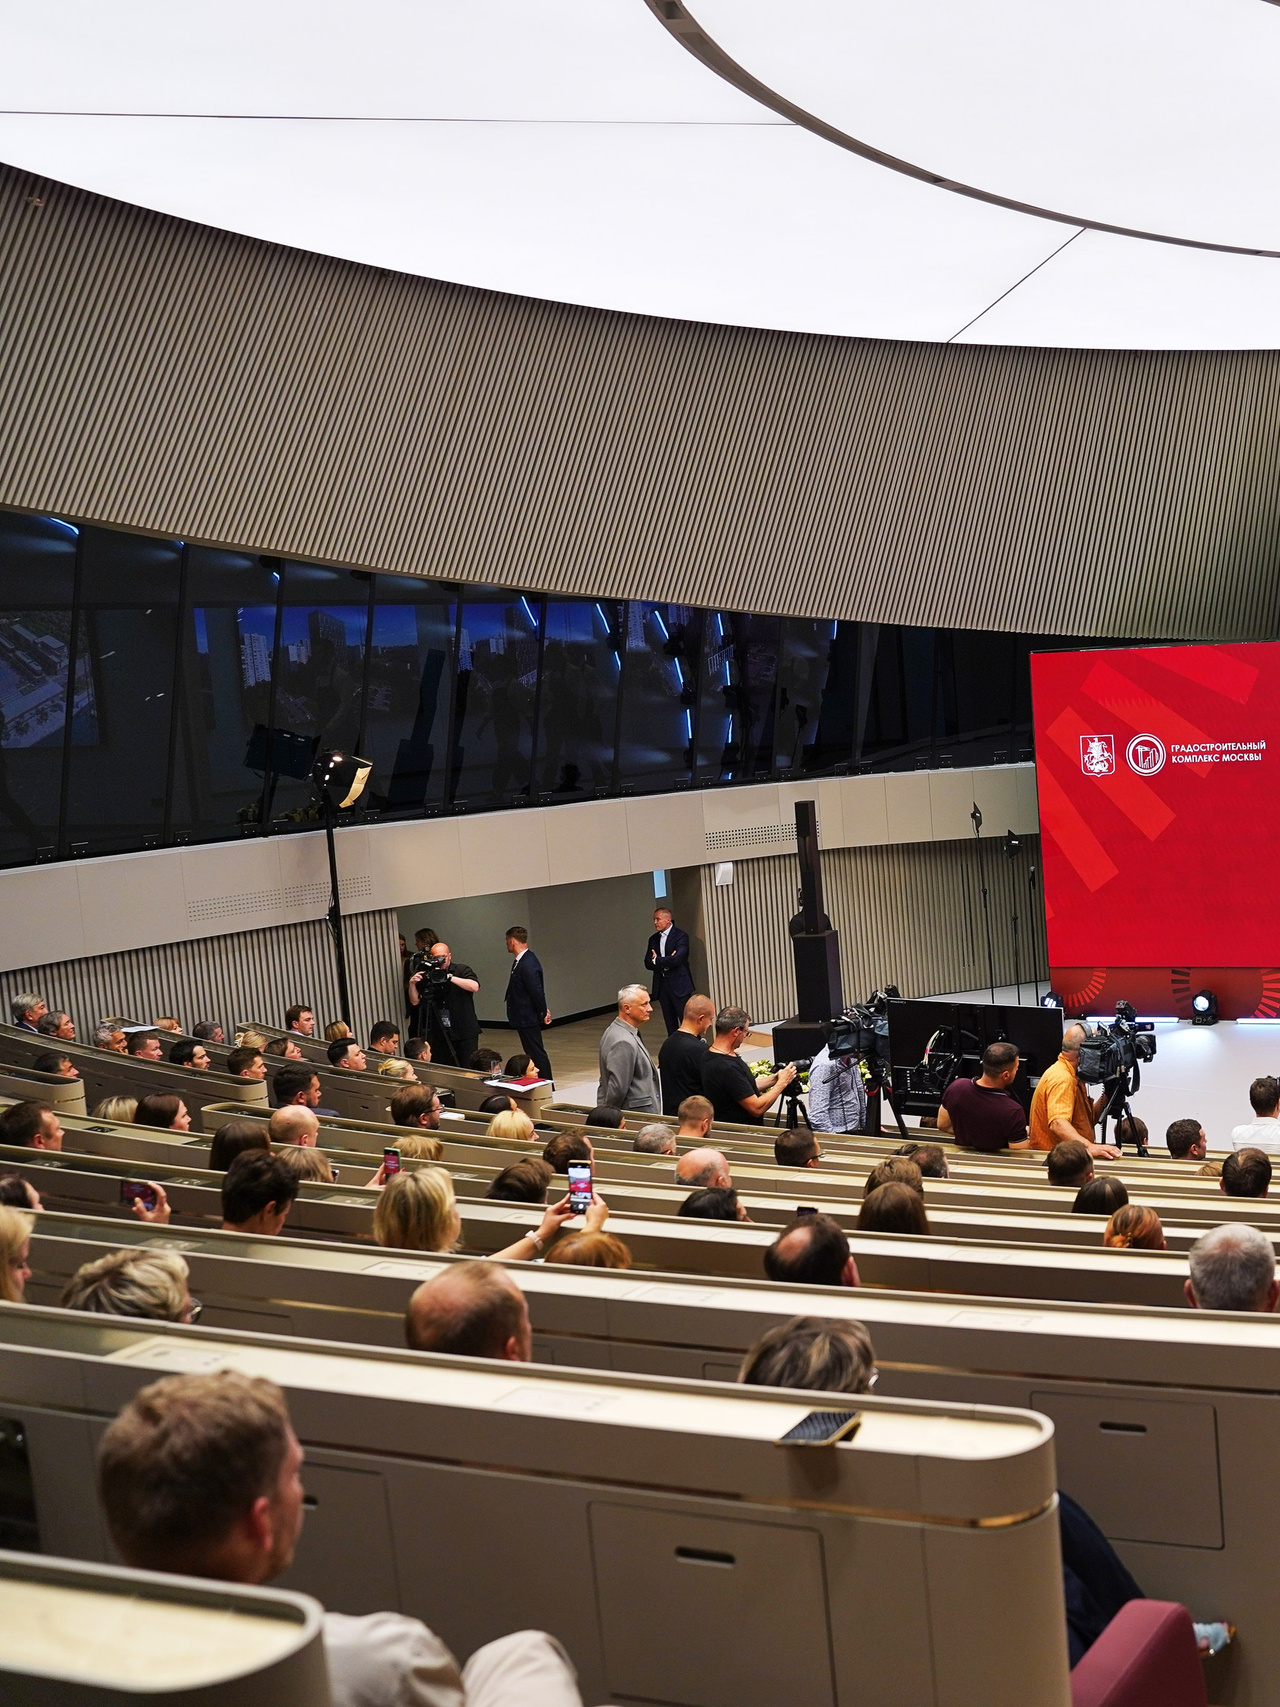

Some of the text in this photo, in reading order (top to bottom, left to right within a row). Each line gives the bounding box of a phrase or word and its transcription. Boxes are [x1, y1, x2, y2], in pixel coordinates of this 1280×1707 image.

[1170, 740, 1267, 753] ГРАДОСТРОИТЕЛЬНЫЙ
[1171, 753, 1262, 764] КОМПЛЕКС МОСКВЫ
